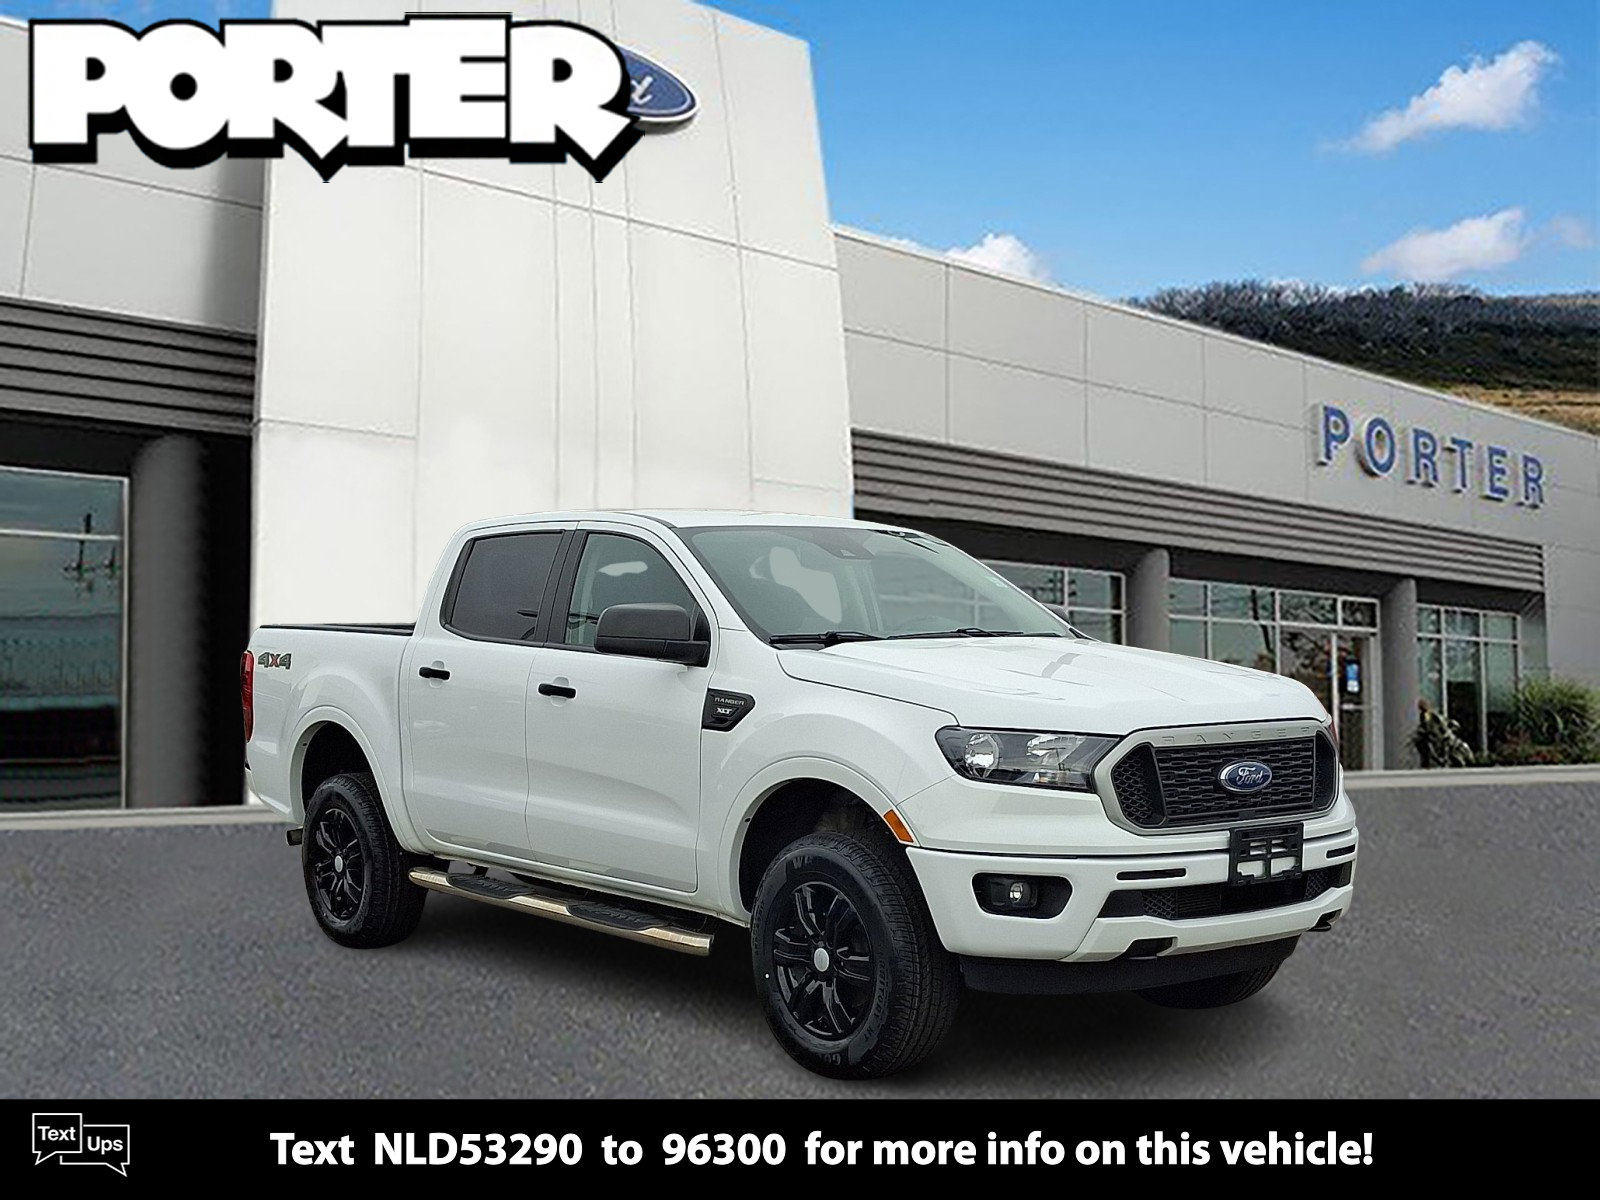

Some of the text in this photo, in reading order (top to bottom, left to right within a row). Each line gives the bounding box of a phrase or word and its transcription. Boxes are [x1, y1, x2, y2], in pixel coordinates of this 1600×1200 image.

[1319, 403, 1545, 507] PORTER
[714, 697, 745, 706] RANGER
[1161, 726, 1310, 743] RANGER
[1236, 766, 1264, 785] Ford
